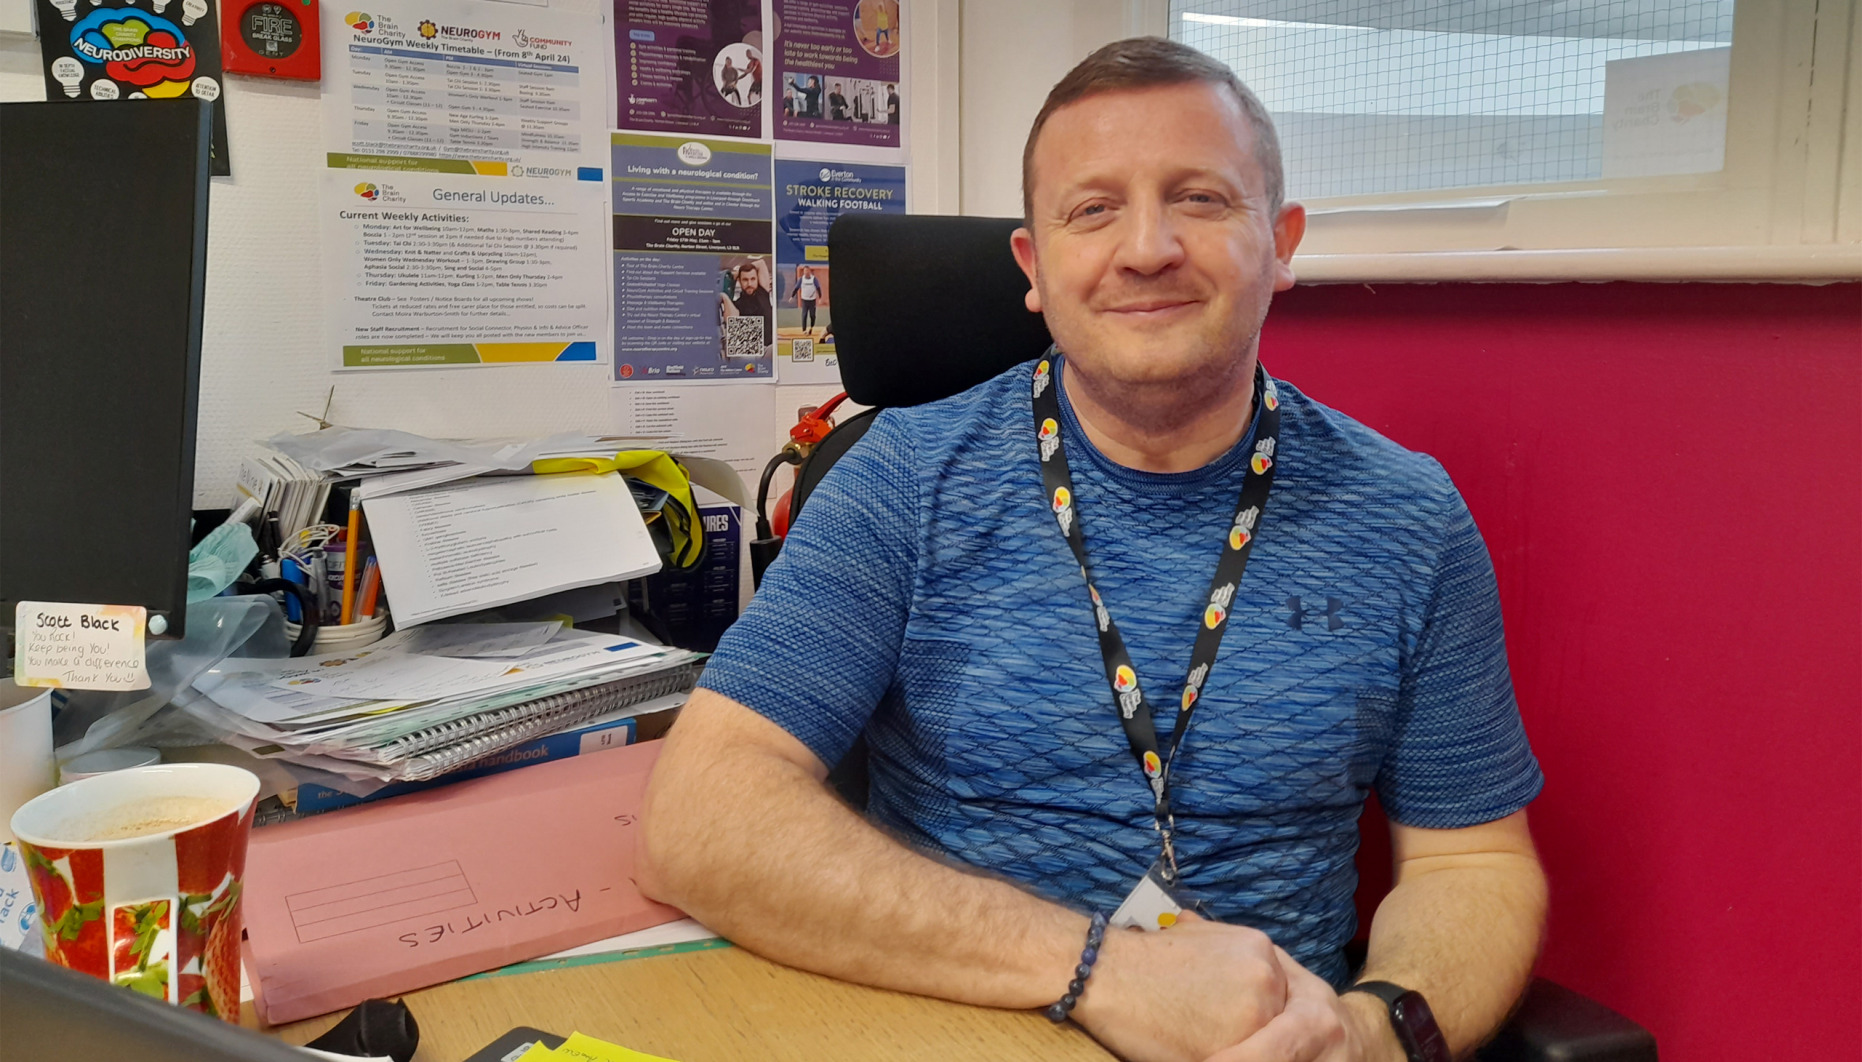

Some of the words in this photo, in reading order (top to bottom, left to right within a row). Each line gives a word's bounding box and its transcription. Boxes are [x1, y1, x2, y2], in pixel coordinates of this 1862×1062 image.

[377, 14, 392, 22] The
[252, 15, 293, 35] FIRE
[378, 22, 398, 30] Brain
[252, 32, 272, 40] BREAK
[378, 29, 406, 39] Charity
[441, 26, 501, 40] NEUROGYM
[530, 37, 572, 46] COMMUNITY
[784, 40, 792, 48] It's
[821, 44, 835, 54] early
[74, 37, 191, 62] NEURODIVERSITY
[353, 34, 404, 46] NeuroGym
[406, 39, 439, 51] Weekly
[440, 44, 485, 54] Timetable
[494, 48, 519, 58] (From
[522, 51, 533, 59] 8th
[535, 53, 555, 62] April
[557, 55, 571, 64] 24)
[784, 49, 796, 57] late
[819, 52, 842, 61] towards
[843, 55, 858, 64] being
[795, 59, 824, 68] healthiest
[526, 167, 572, 176] NEUROGYM
[627, 165, 651, 175] Living
[653, 167, 670, 175] with
[678, 170, 722, 179] neurological
[723, 172, 758, 180] condition?
[831, 170, 854, 178] Everton
[433, 188, 486, 202] General
[490, 191, 555, 206] Updates...
[786, 184, 832, 197] STROKE
[834, 187, 893, 200] RECOVERY
[798, 198, 838, 208] WALKING
[840, 200, 883, 210] FOOTBALL
[340, 210, 378, 220] Current
[382, 212, 418, 222] Weekly
[422, 213, 470, 223] Activities:
[672, 227, 697, 236] OPEN
[699, 228, 716, 237] DAY
[36, 612, 72, 628] Scott
[80, 614, 119, 632] Black
[32, 630, 46, 641] You
[29, 642, 52, 654] Keep
[56, 643, 84, 658] being
[90, 642, 110, 655] You!
[28, 656, 40, 666] You
[45, 658, 68, 666] make
[73, 657, 80, 666] a
[85, 658, 139, 669] difference
[62, 670, 99, 682] Thank
[476, 745, 548, 771] handbook
[317, 788, 333, 800] the
[0, 888, 20, 924] ack
